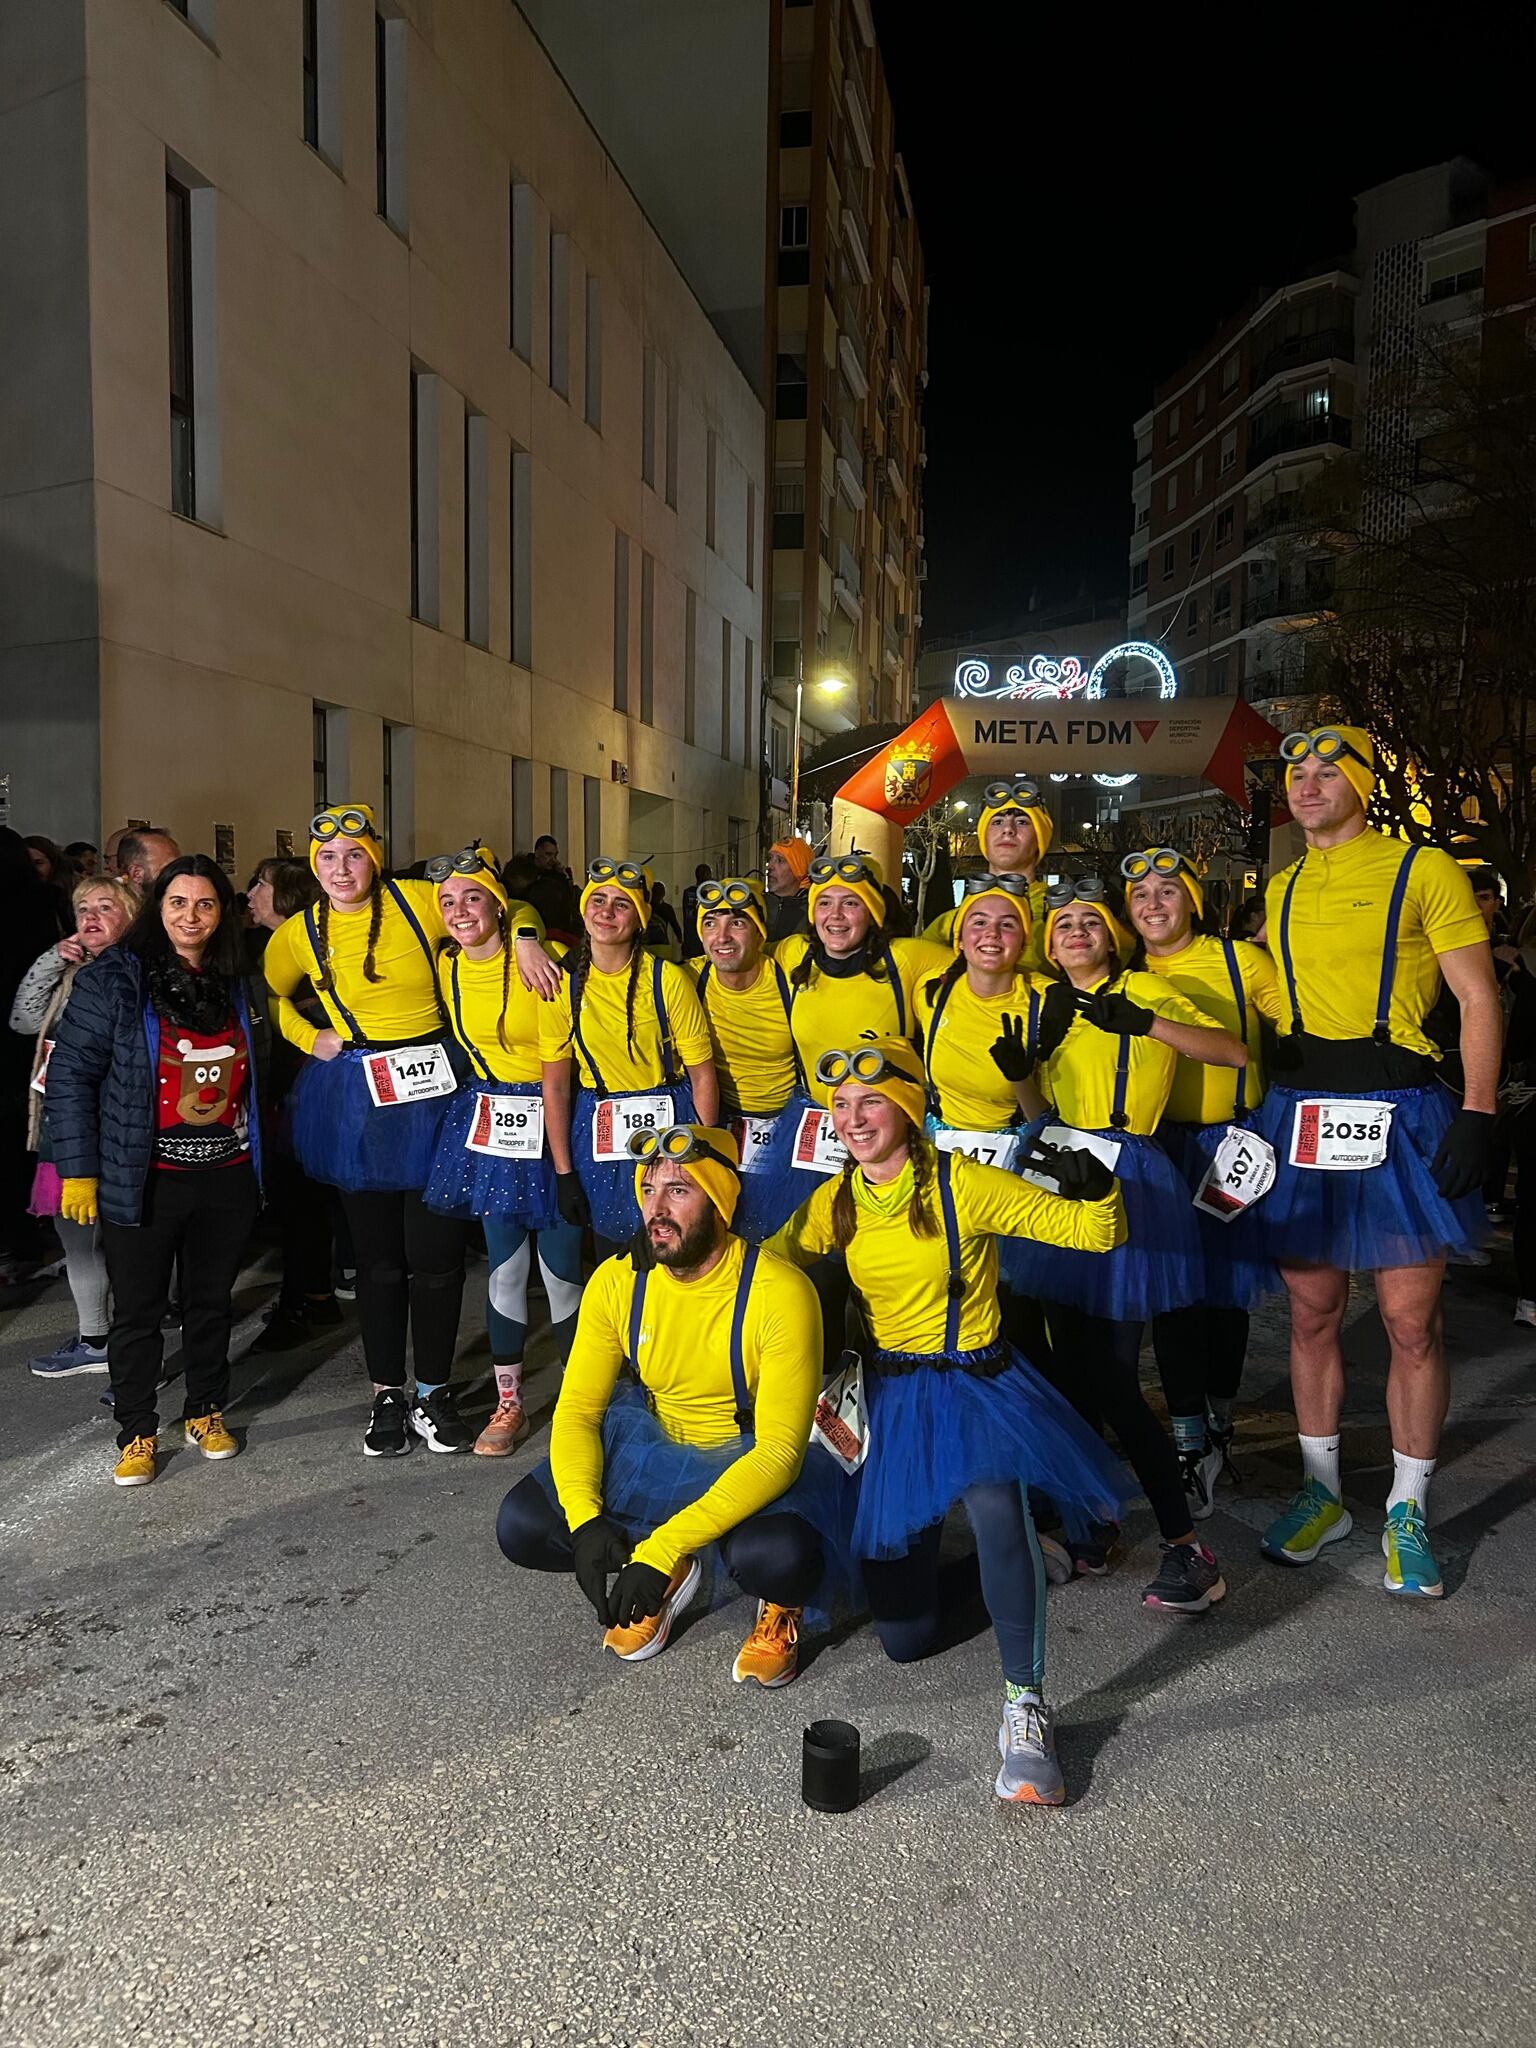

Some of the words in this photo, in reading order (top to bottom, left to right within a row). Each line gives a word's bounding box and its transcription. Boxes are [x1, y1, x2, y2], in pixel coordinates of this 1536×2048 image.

[974, 719, 1058, 744] META
[1067, 720, 1131, 744] FDM
[372, 1065, 387, 1074] SAN
[396, 1061, 436, 1080] 1417
[375, 1080, 390, 1088] VES
[377, 1087, 391, 1095] TRE
[495, 1112, 528, 1128] 289
[623, 1113, 656, 1129] 188
[1301, 1115, 1317, 1123] SAN
[597, 1125, 610, 1134] VES
[1300, 1124, 1312, 1133] SIL
[1321, 1122, 1382, 1140] 2038
[597, 1134, 611, 1142] TRE
[752, 1131, 776, 1146] 28
[821, 1126, 840, 1143] 14
[1300, 1133, 1316, 1142] VES
[1299, 1142, 1314, 1152] TRE
[1225, 1146, 1253, 1189] 307
